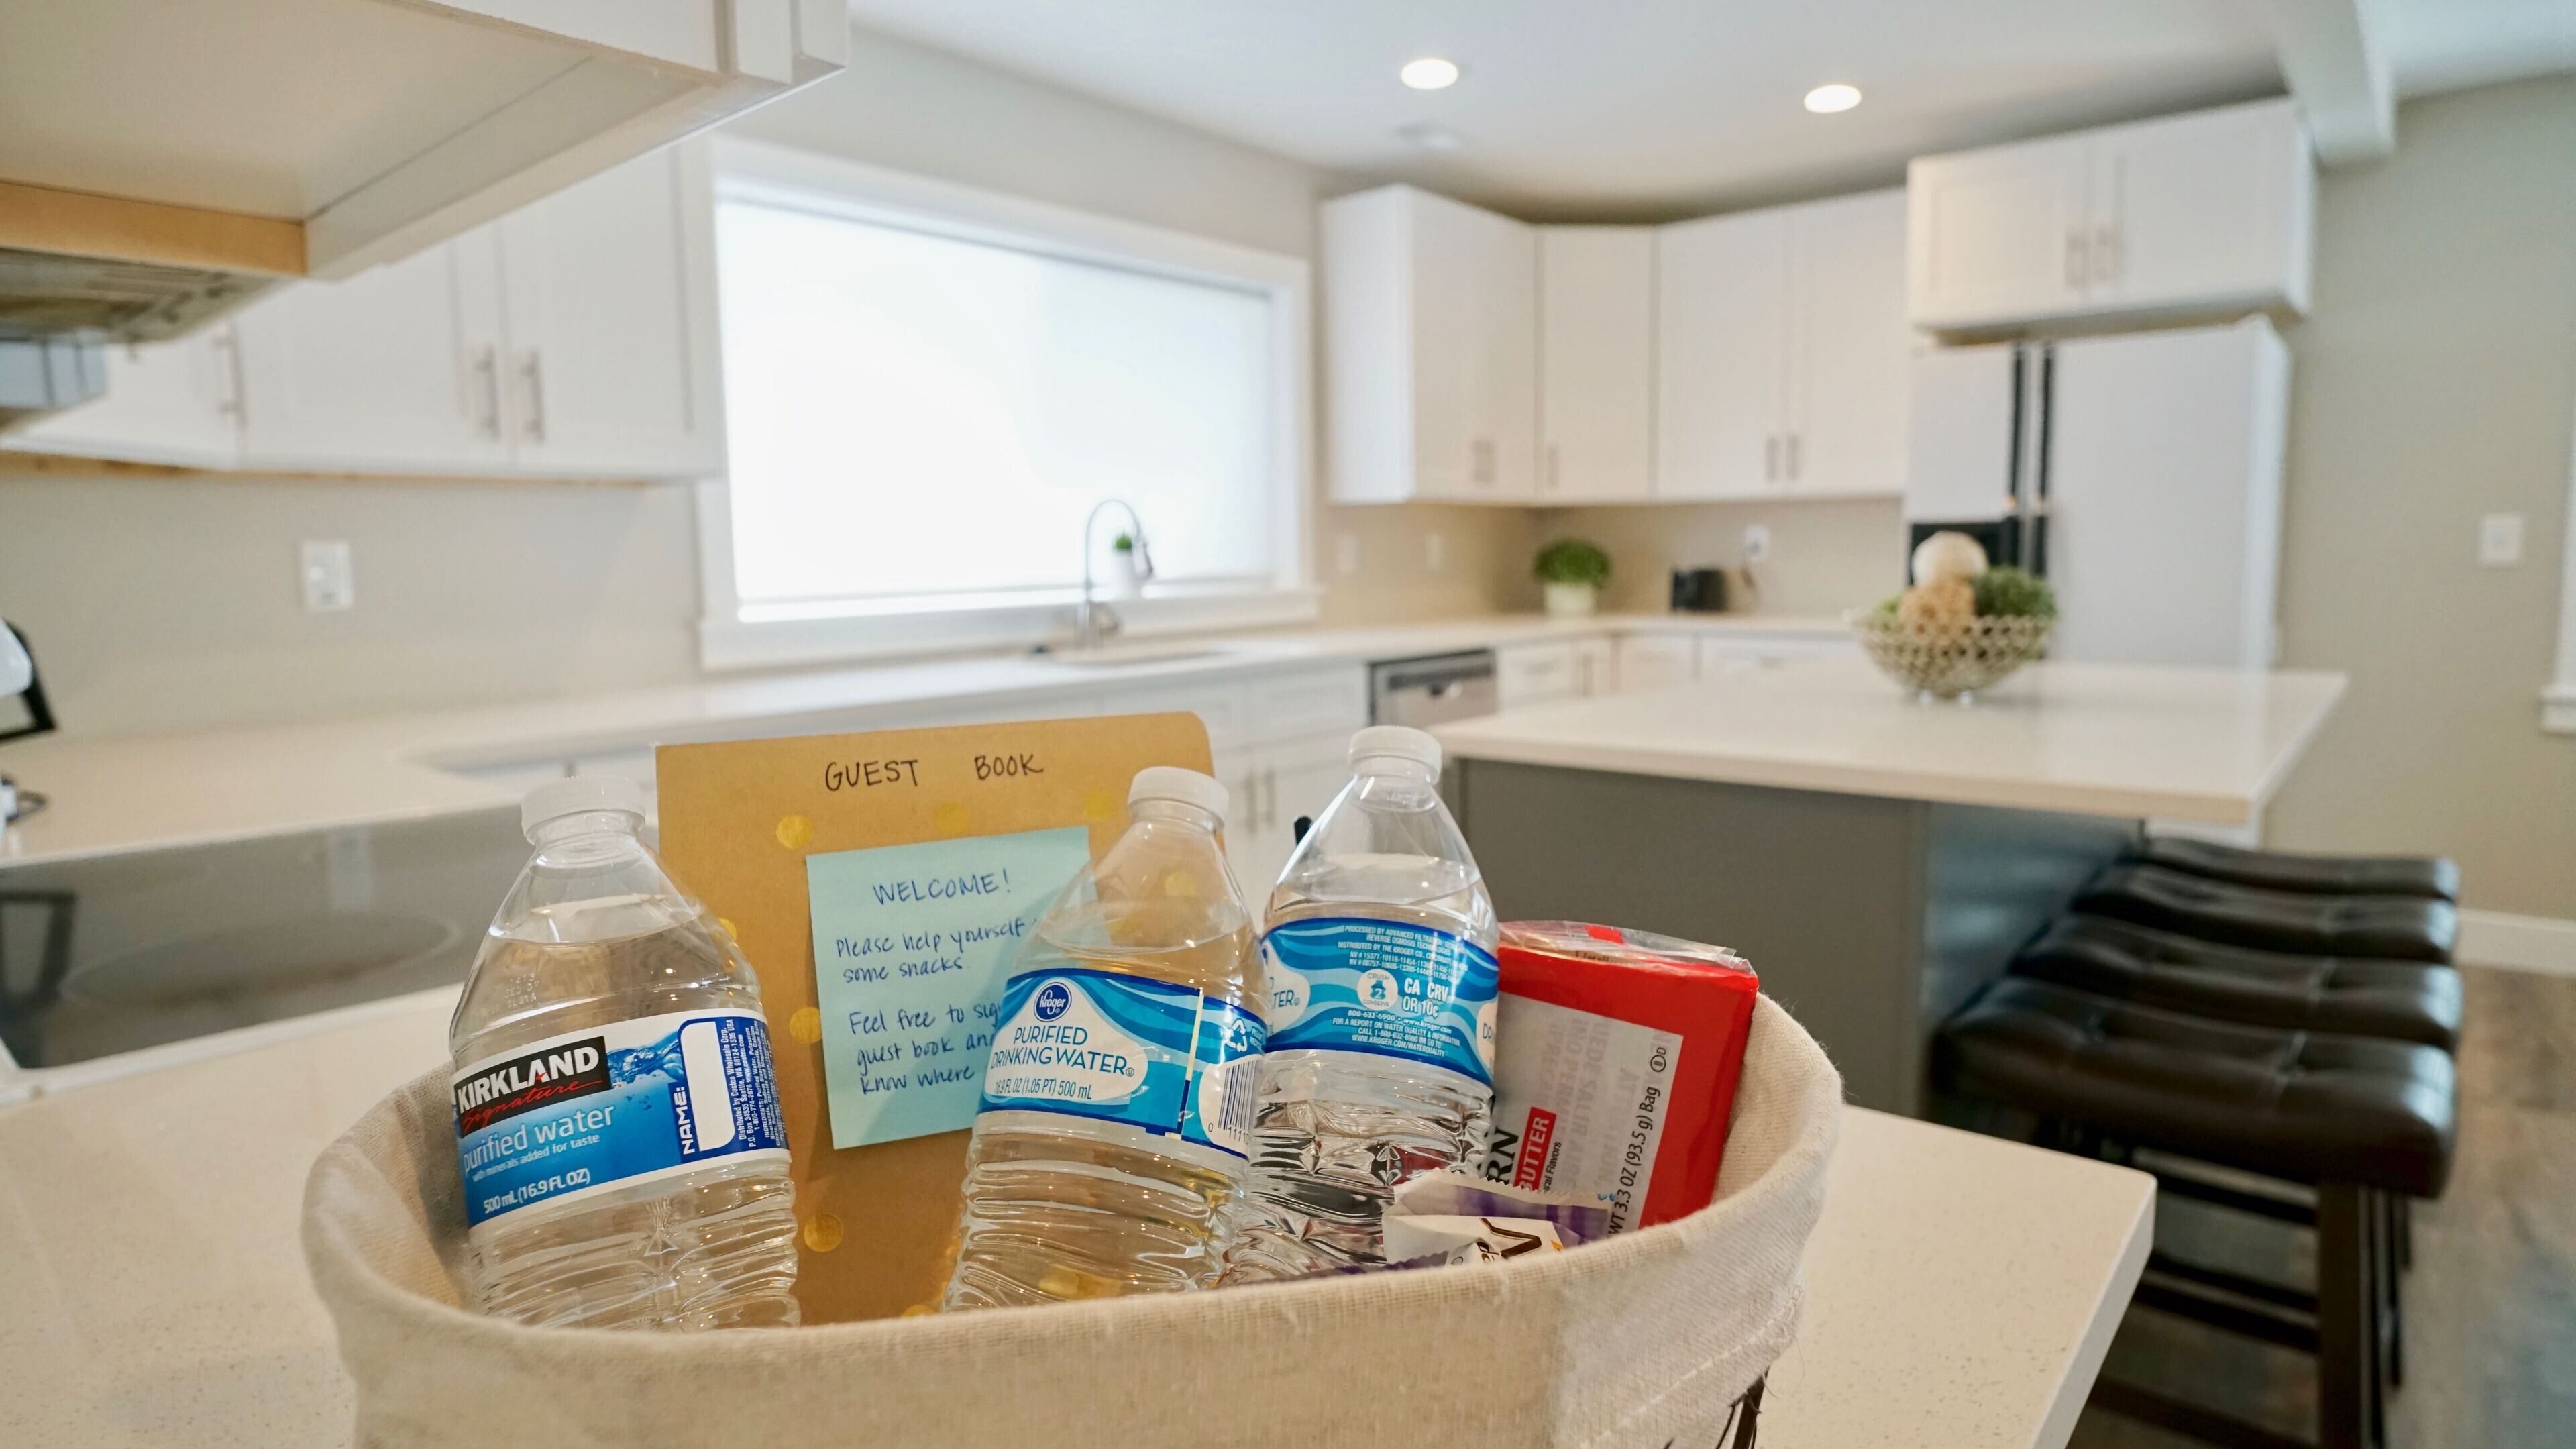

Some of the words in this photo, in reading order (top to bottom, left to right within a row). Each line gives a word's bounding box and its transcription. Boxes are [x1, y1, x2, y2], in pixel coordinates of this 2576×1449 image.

[825, 759, 918, 792] GUEST
[974, 753, 1044, 781] BOOK
[872, 869, 1010, 905] WELCOME!
[835, 936, 894, 958] Please
[904, 933, 941, 953] help
[950, 918, 1025, 953] yourself
[1377, 927, 1385, 935] BY
[1382, 944, 1393, 953] THE
[1393, 946, 1415, 955] KROGER
[843, 965, 889, 984] some
[899, 957, 963, 977] snacks
[1039, 989, 1067, 1015] Kroger
[1375, 988, 1383, 999] 2
[1404, 977, 1421, 996] CA
[1426, 982, 1449, 1002] CRV
[1402, 996, 1419, 1012] OR
[726, 1019, 735, 1031] USA
[849, 1009, 887, 1034] Feel
[898, 1008, 936, 1030] free
[945, 1004, 965, 1023] to
[1347, 1010, 1395, 1021] 800-632-6900
[1403, 1018, 1452, 1034] www.kroger.com
[1350, 1019, 1373, 1028] REPORT
[1374, 1021, 1383, 1029] ON
[1383, 1022, 1403, 1032] WATER
[1404, 1026, 1427, 1037] QUALITY
[1358, 1027, 1373, 1036] CALL
[1013, 1025, 1088, 1045] PURIFIED
[722, 1044, 735, 1075] Wholesale
[729, 1032, 741, 1066] 98124-1535
[738, 1034, 751, 1083] www.costco.com
[857, 1042, 902, 1077] guest
[912, 1038, 955, 1058] book
[990, 1046, 1053, 1070] DRINKING
[1056, 1048, 1128, 1075] WATER
[458, 1046, 600, 1114] KIRKLAND
[735, 1067, 743, 1077] WA
[859, 1075, 907, 1095] know
[917, 1065, 975, 1087] where
[729, 1076, 739, 1097] Costco
[738, 1079, 748, 1102] Seattle,
[754, 1075, 763, 1097] Purified
[1012, 1078, 1024, 1093] OZ
[1022, 1076, 1041, 1095] (1.05
[1041, 1077, 1057, 1096] PT)
[1058, 1080, 1077, 1097] 500
[1077, 1084, 1092, 1100] mL
[733, 1097, 742, 1106] by
[742, 1103, 751, 1121] 34535
[1638, 1086, 1661, 1113] Bag
[674, 1086, 695, 1155] NAME:
[733, 1106, 747, 1140] Distributed
[746, 1122, 754, 1134] Box
[759, 1099, 770, 1138] INGREDIENTS:
[1636, 1115, 1654, 1131] g)
[463, 1124, 528, 1178] purified
[534, 1106, 614, 1141] water
[747, 1134, 756, 1148] P.O.
[1625, 1130, 1647, 1166] (93.5
[486, 1157, 519, 1177] minerals
[520, 1146, 550, 1164] added
[552, 1142, 568, 1154] for
[571, 1134, 600, 1149] taste
[1545, 1142, 1562, 1175] Flavors
[1619, 1167, 1638, 1187] OZ
[483, 1195, 501, 1214] 500
[502, 1191, 519, 1207] mL
[549, 1175, 567, 1191] FL
[566, 1167, 591, 1186] OZ)
[1614, 1189, 1632, 1212] 3.3
[1608, 1212, 1625, 1234] WT
